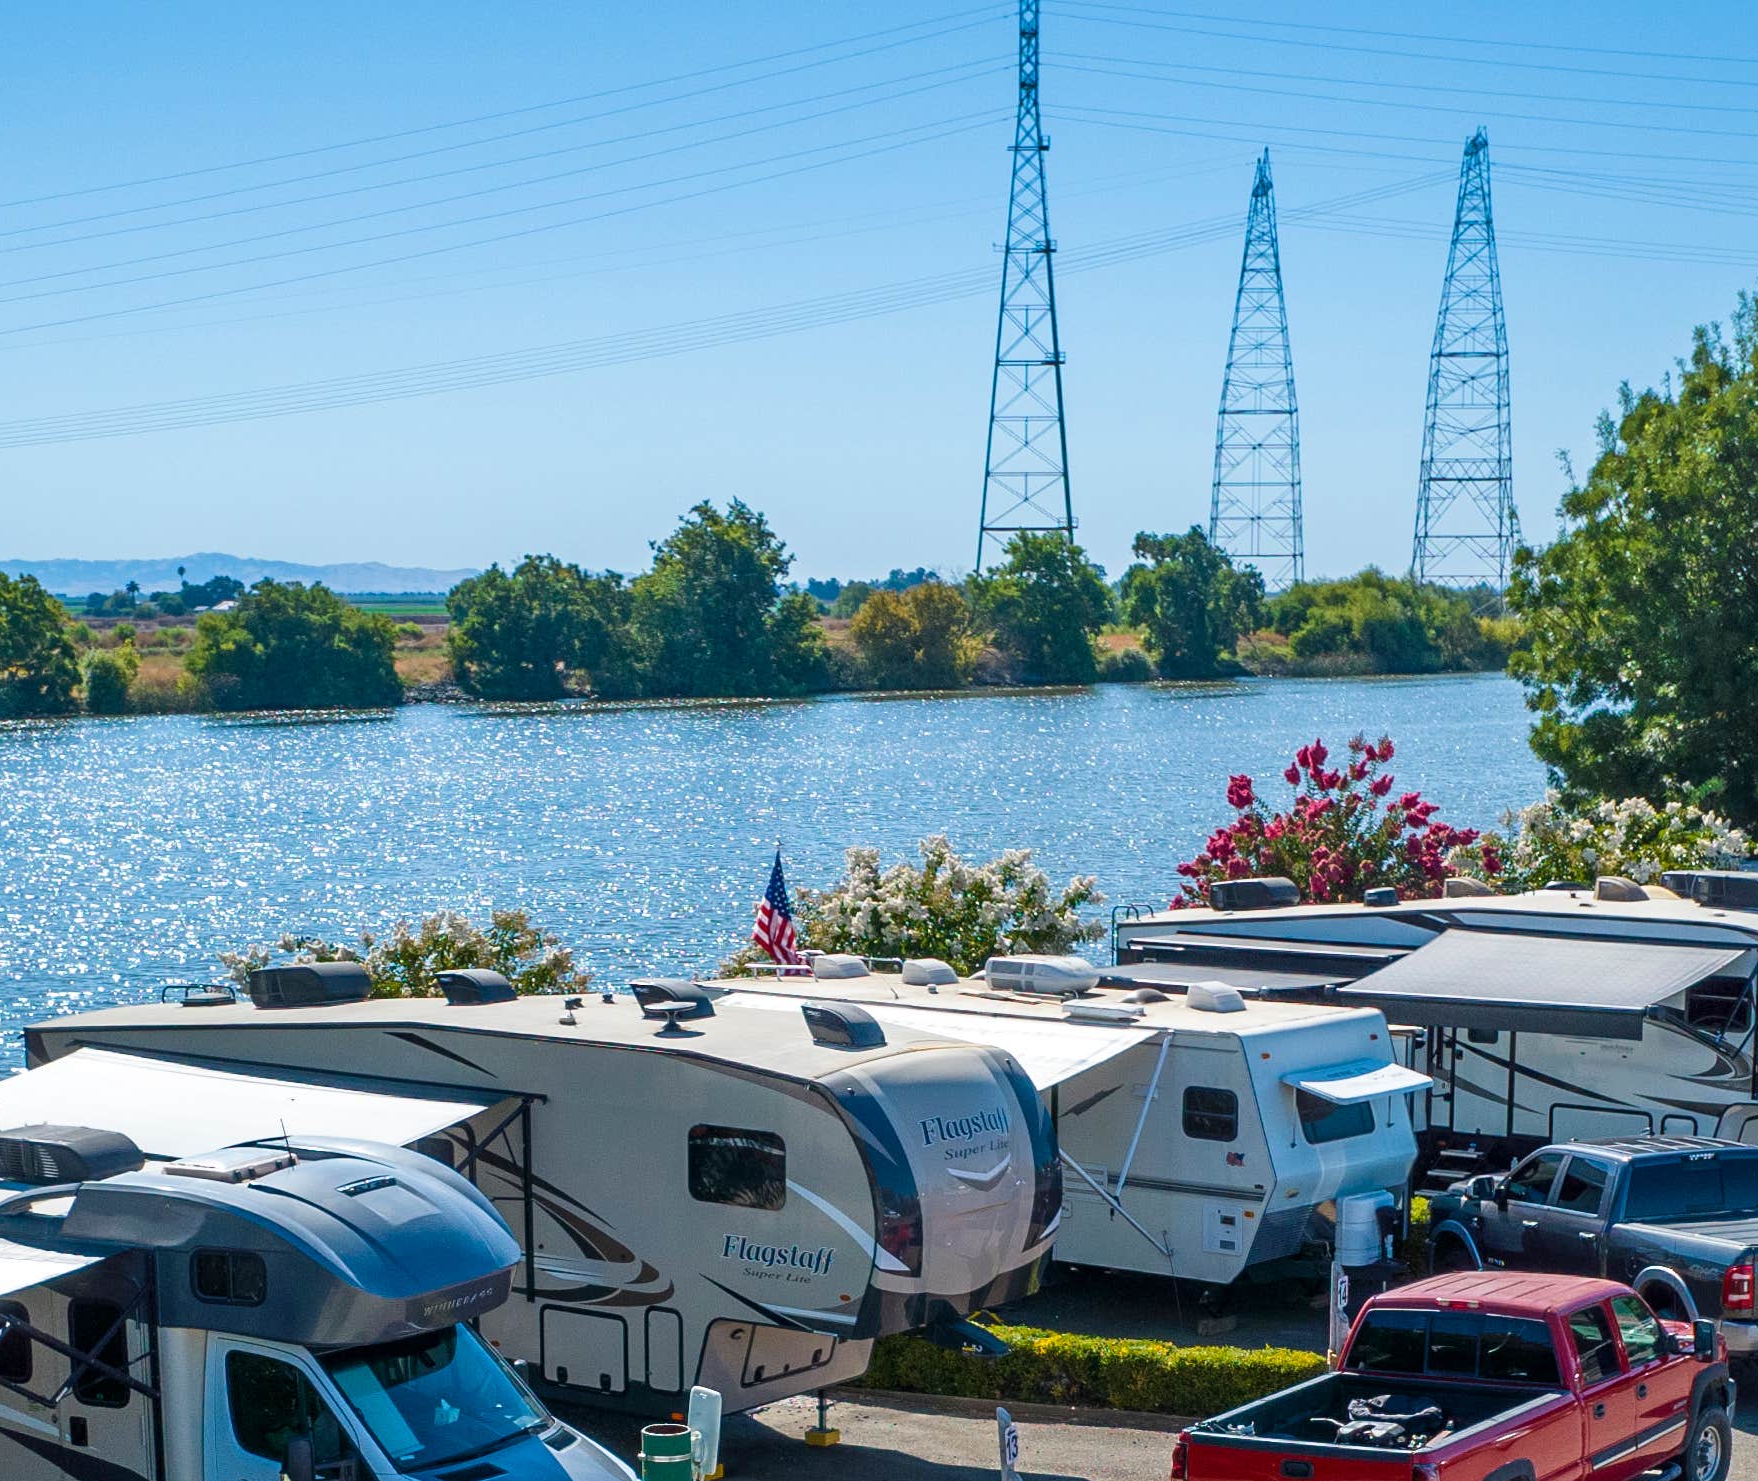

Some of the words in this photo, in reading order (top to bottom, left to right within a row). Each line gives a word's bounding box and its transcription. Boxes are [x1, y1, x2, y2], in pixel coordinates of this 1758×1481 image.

[918, 1106, 1010, 1147] Flagstaff
[944, 1144, 986, 1160] Super
[722, 1233, 836, 1275] Flagstaff
[743, 1267, 780, 1280] Super
[786, 1272, 812, 1284] Lite
[1006, 1433, 1019, 1460] 13
